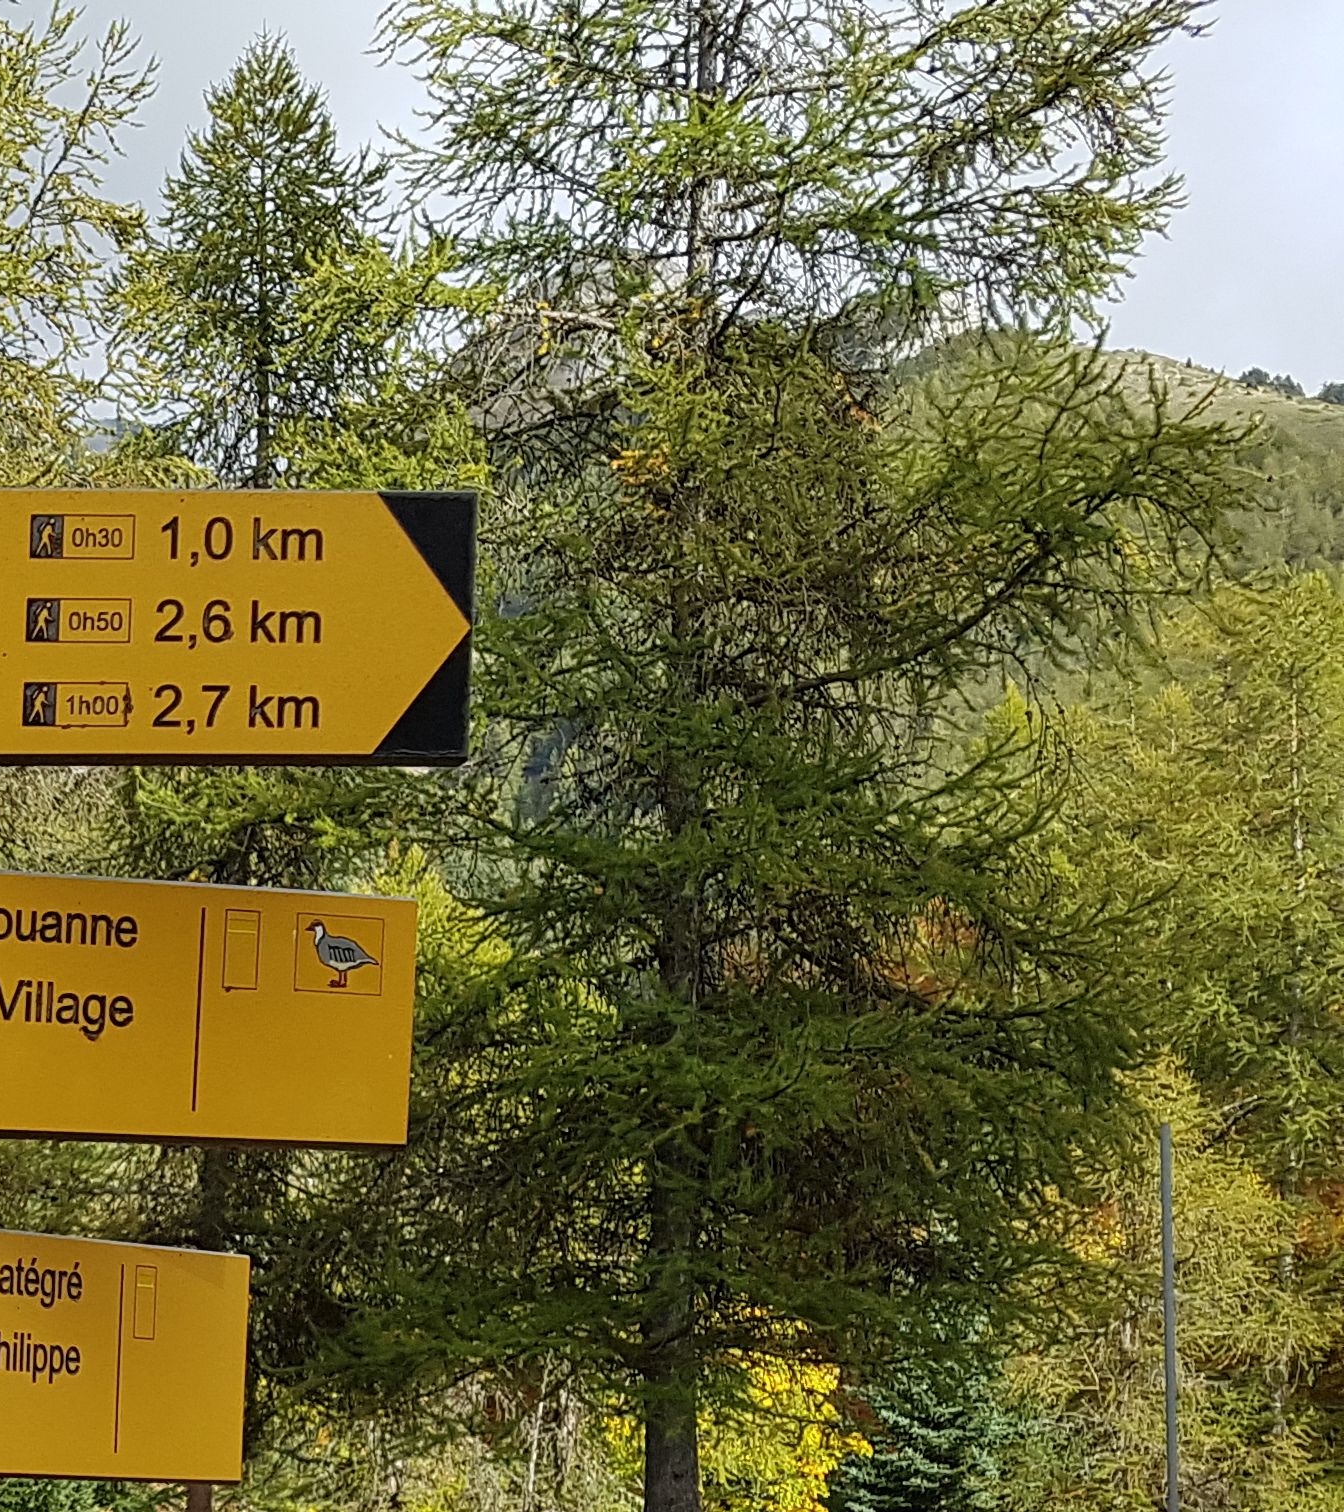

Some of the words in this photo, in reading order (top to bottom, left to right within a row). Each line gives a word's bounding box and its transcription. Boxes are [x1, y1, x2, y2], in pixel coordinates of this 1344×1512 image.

[71, 527, 123, 548] 0h30
[161, 516, 233, 567] 1,0
[252, 517, 323, 560] km
[68, 611, 123, 631] 0h50
[154, 599, 234, 650] 2,6
[250, 600, 322, 643] km
[65, 695, 119, 715] 1h00
[152, 684, 231, 735] 2,7
[248, 685, 320, 728] km
